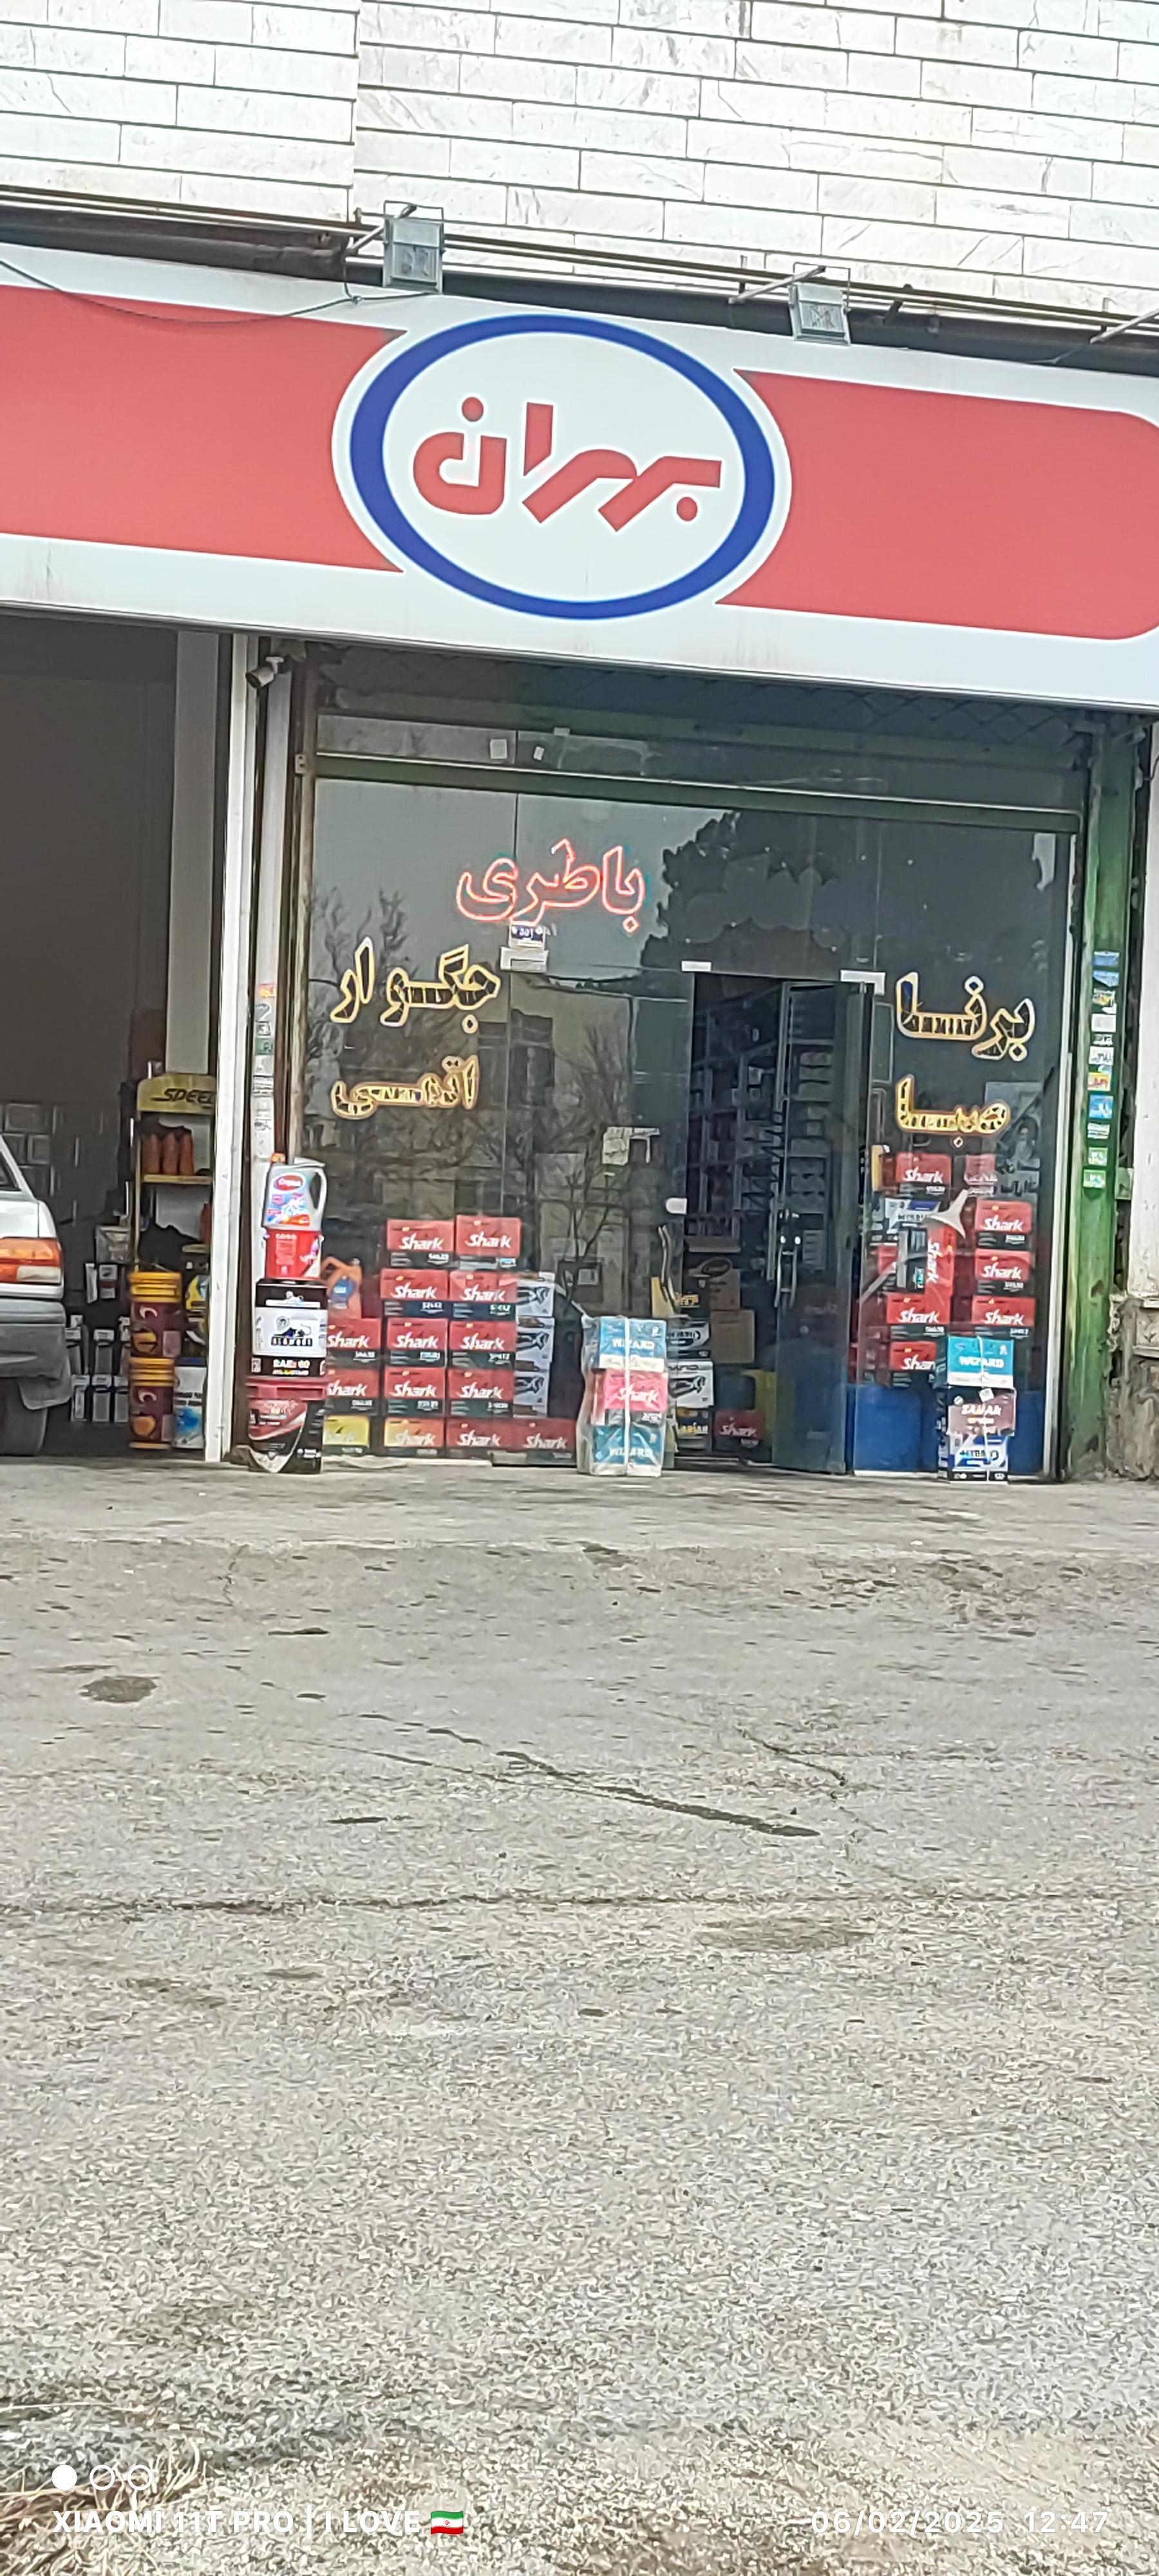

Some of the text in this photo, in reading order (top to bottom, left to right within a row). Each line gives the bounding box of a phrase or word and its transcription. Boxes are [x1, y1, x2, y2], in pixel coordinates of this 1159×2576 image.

[413, 397, 722, 532] بهران
[455, 838, 645, 933] باطری
[896, 972, 1035, 1062] برنا
[151, 1088, 217, 1104] SPEE
[896, 1074, 1011, 1148] صبا
[903, 1167, 943, 1184] Shark
[981, 1215, 1022, 1231] Shark
[398, 1233, 444, 1250] Shark
[464, 1231, 511, 1249] Shark
[927, 1237, 943, 1283] Shark
[981, 1262, 1021, 1279] Shark
[390, 1282, 437, 1299] Shark
[460, 1283, 506, 1302] Shark
[896, 1307, 939, 1323] Shark
[981, 1309, 1024, 1326] Shark
[327, 1331, 370, 1348] Shark
[391, 1331, 439, 1348] Shark
[459, 1332, 505, 1350] Shark
[901, 1354, 934, 1370] Shar
[389, 1380, 438, 1397] Shark
[456, 1381, 504, 1399] Shark
[617, 1384, 660, 1402] Shark
[456, 1429, 502, 1447] Shark
[523, 1433, 568, 1449] Shark
